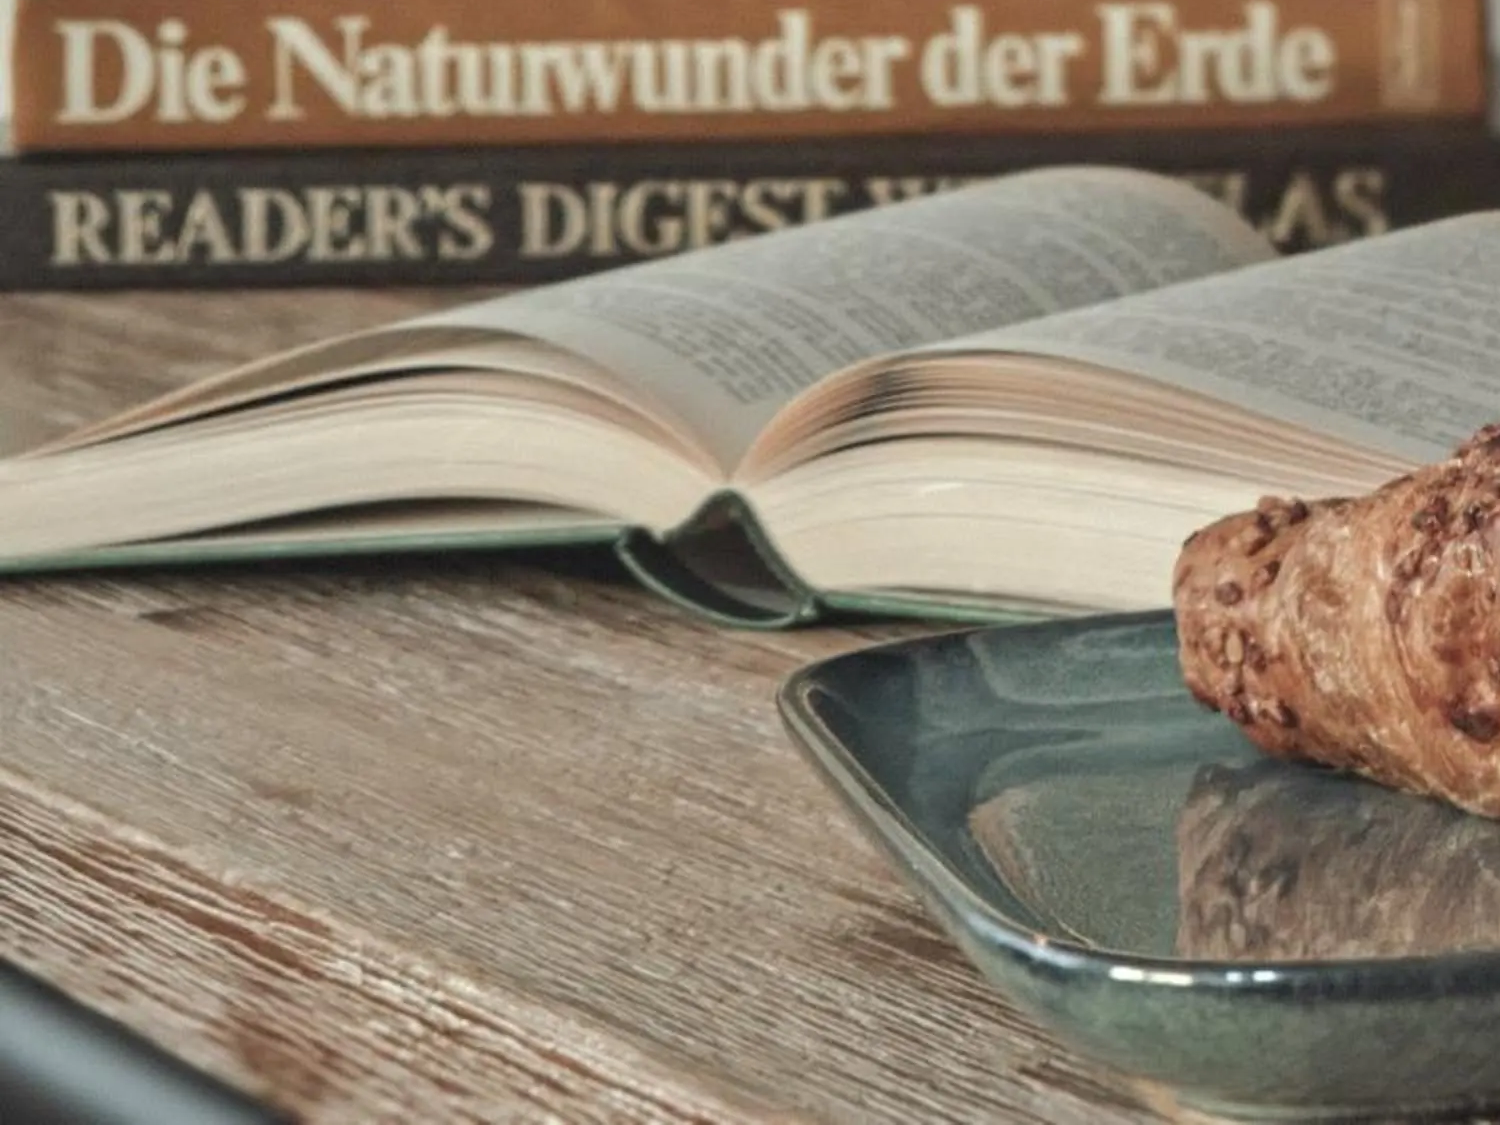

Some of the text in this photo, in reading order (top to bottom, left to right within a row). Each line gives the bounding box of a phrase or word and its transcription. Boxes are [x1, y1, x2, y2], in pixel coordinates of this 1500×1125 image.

[54, 17, 248, 125] Die
[266, 9, 909, 119] Naturwunder
[920, 3, 1087, 108] der
[47, 185, 495, 267] READER'S
[519, 177, 850, 257] DIGEST
